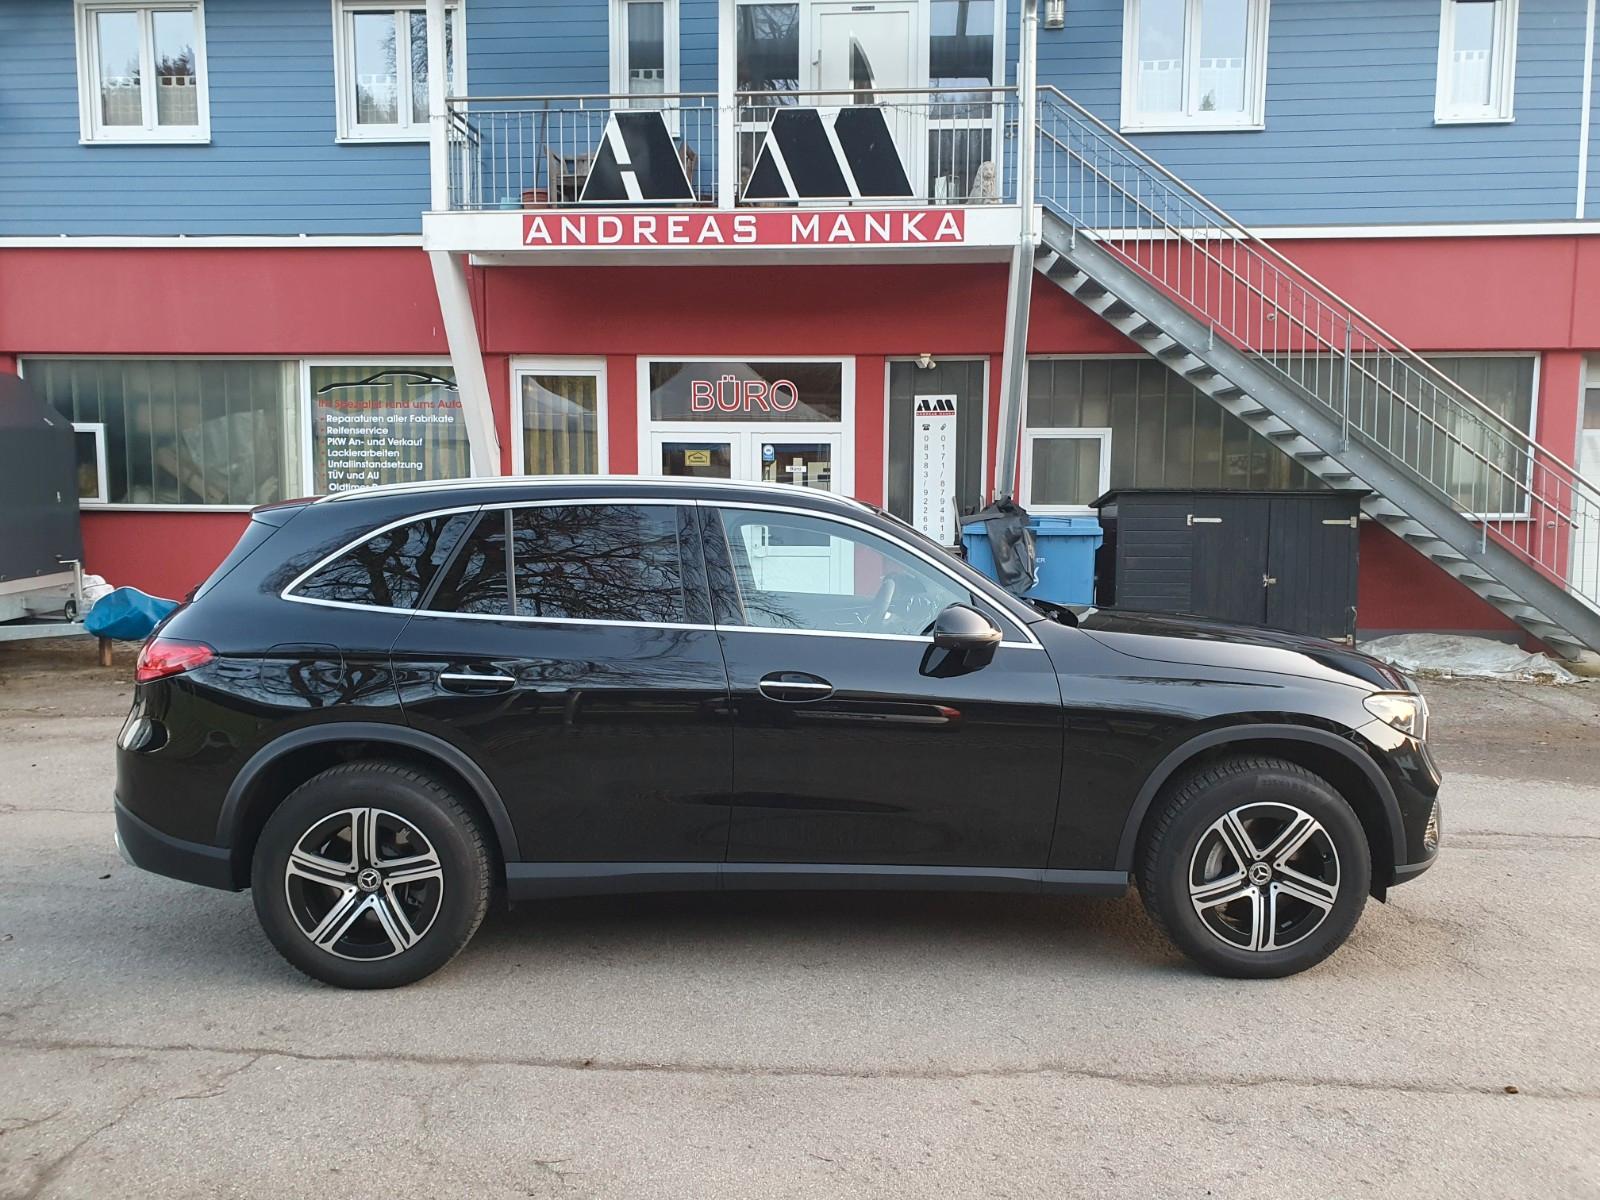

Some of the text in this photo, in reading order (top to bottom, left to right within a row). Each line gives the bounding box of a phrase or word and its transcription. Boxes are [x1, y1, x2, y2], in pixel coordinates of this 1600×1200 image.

[525, 212, 963, 244] ANDREAS MANKA
[691, 375, 799, 412] BÜRO
[326, 414, 454, 424] Reparaturen aller Fabrikate
[326, 426, 389, 435] Reifenservice
[327, 437, 423, 446] PKW An- und Verkauf
[327, 449, 400, 457] Lackierarbeiten
[328, 460, 423, 471] Unfallinstandsetzung
[328, 469, 379, 479] TÜV und AU
